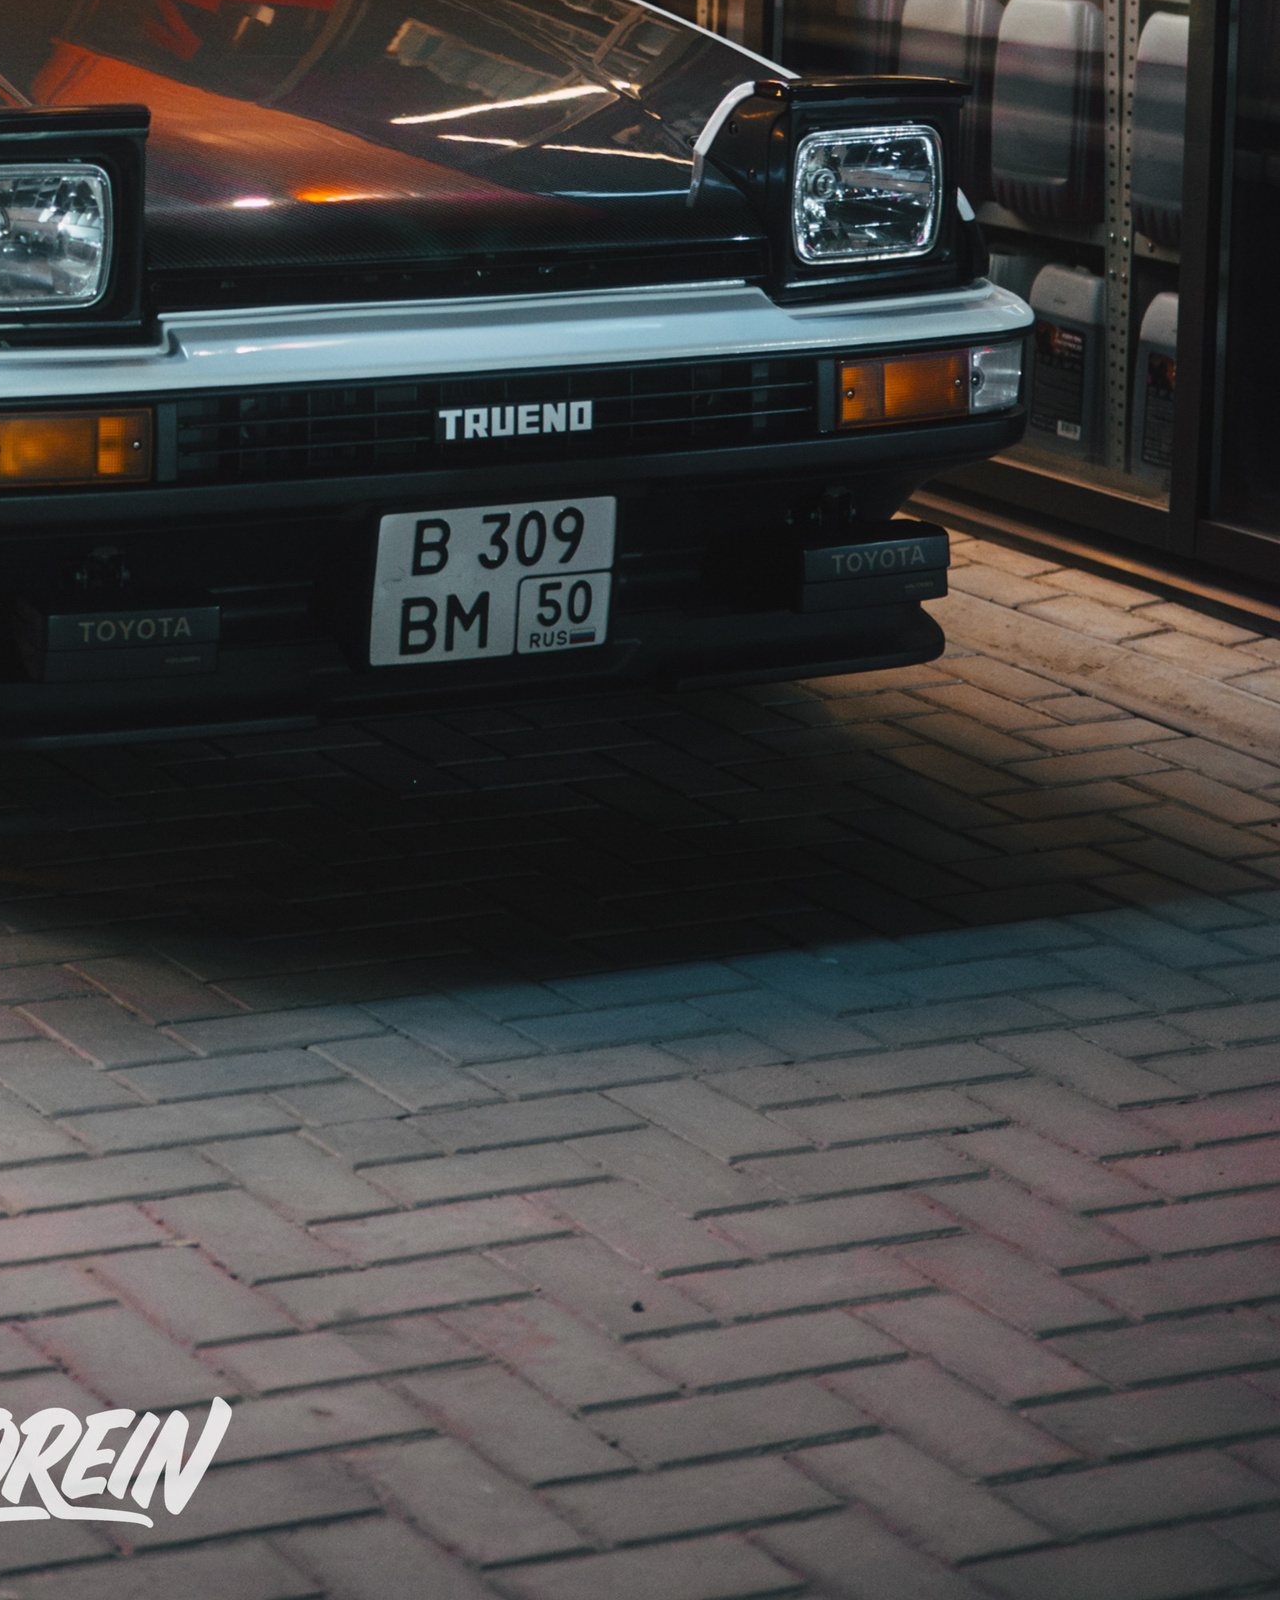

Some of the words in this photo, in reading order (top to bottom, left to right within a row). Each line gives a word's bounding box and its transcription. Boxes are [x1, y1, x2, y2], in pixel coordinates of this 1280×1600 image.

[438, 400, 593, 441] TRUENO
[411, 518, 451, 576] B
[478, 506, 585, 570] 309
[831, 545, 926, 574] TOYOTA
[399, 591, 490, 656] BM
[536, 580, 592, 627] 50
[78, 616, 192, 643] TOYOTA
[529, 630, 568, 649] RUS
